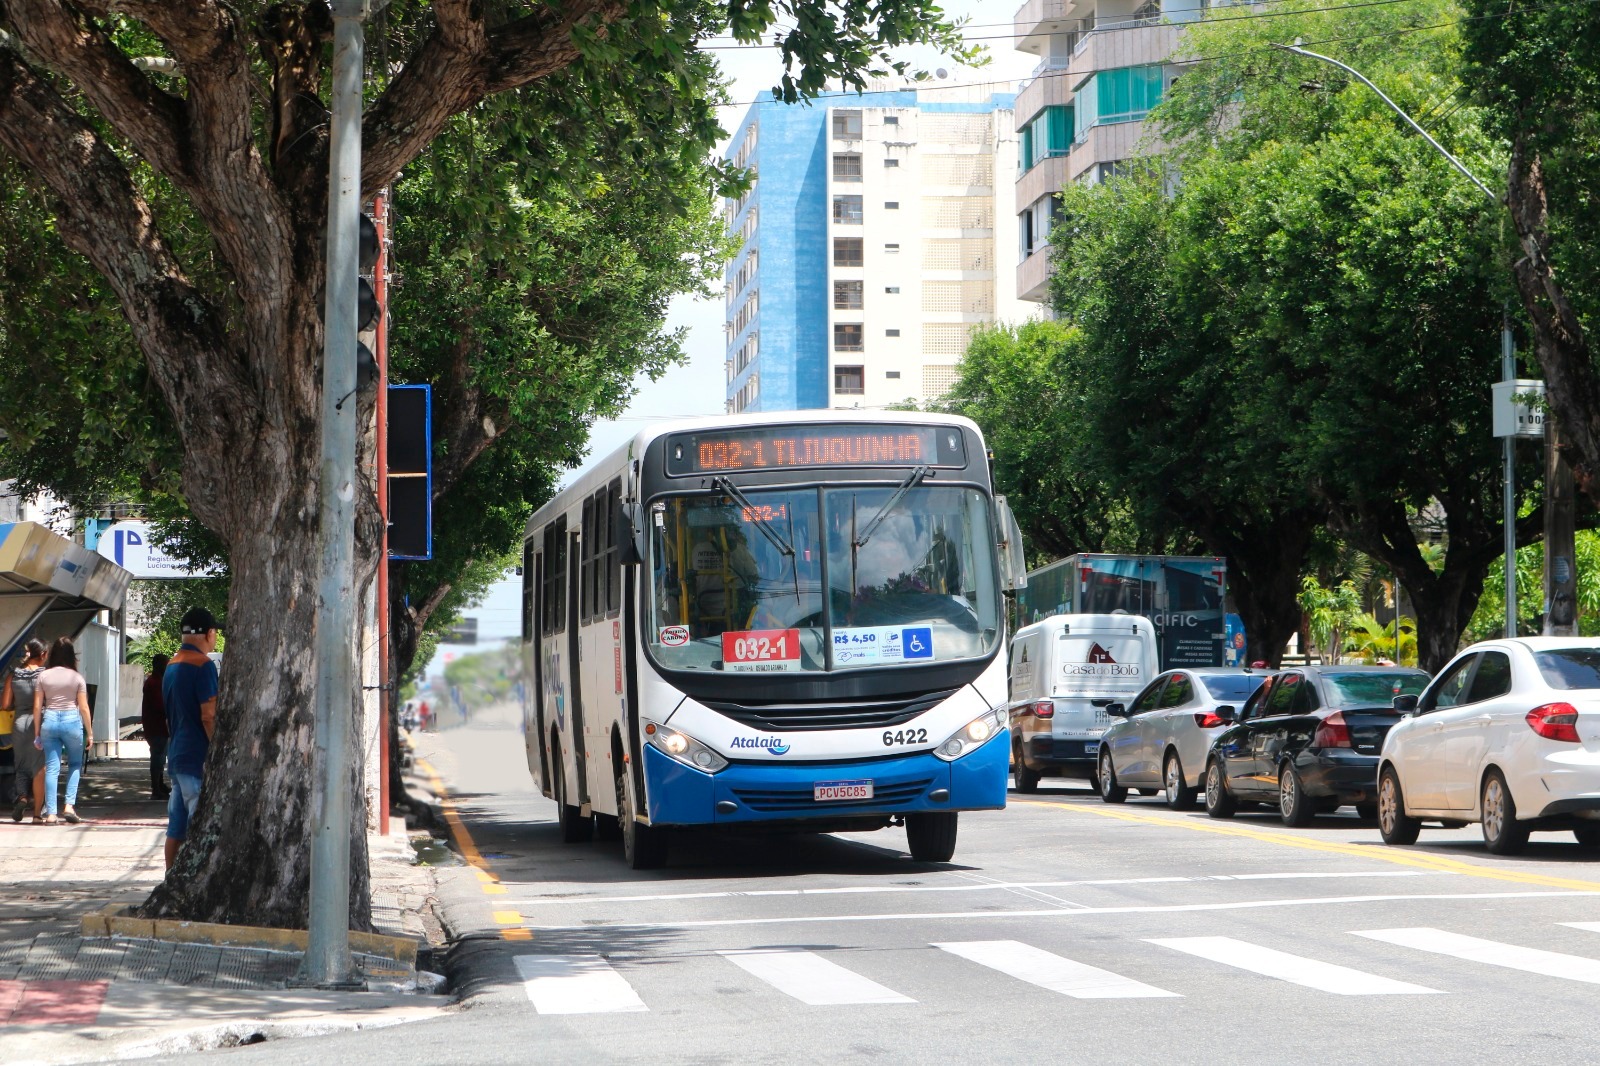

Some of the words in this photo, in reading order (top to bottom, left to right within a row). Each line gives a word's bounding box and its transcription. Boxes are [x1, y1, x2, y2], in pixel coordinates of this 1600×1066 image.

[700, 441, 767, 468] 032-1
[773, 434, 920, 465] TIJUQUINHA
[834, 635, 849, 644] R$
[852, 634, 876, 644] 4,50
[734, 637, 786, 659] 032-1
[1063, 664, 1096, 675] Casa
[1096, 667, 1109, 675] do
[1111, 665, 1139, 676] Bolo
[730, 736, 784, 748] Atalaia
[882, 728, 928, 746] 6422
[820, 786, 867, 798] PCV5C85
